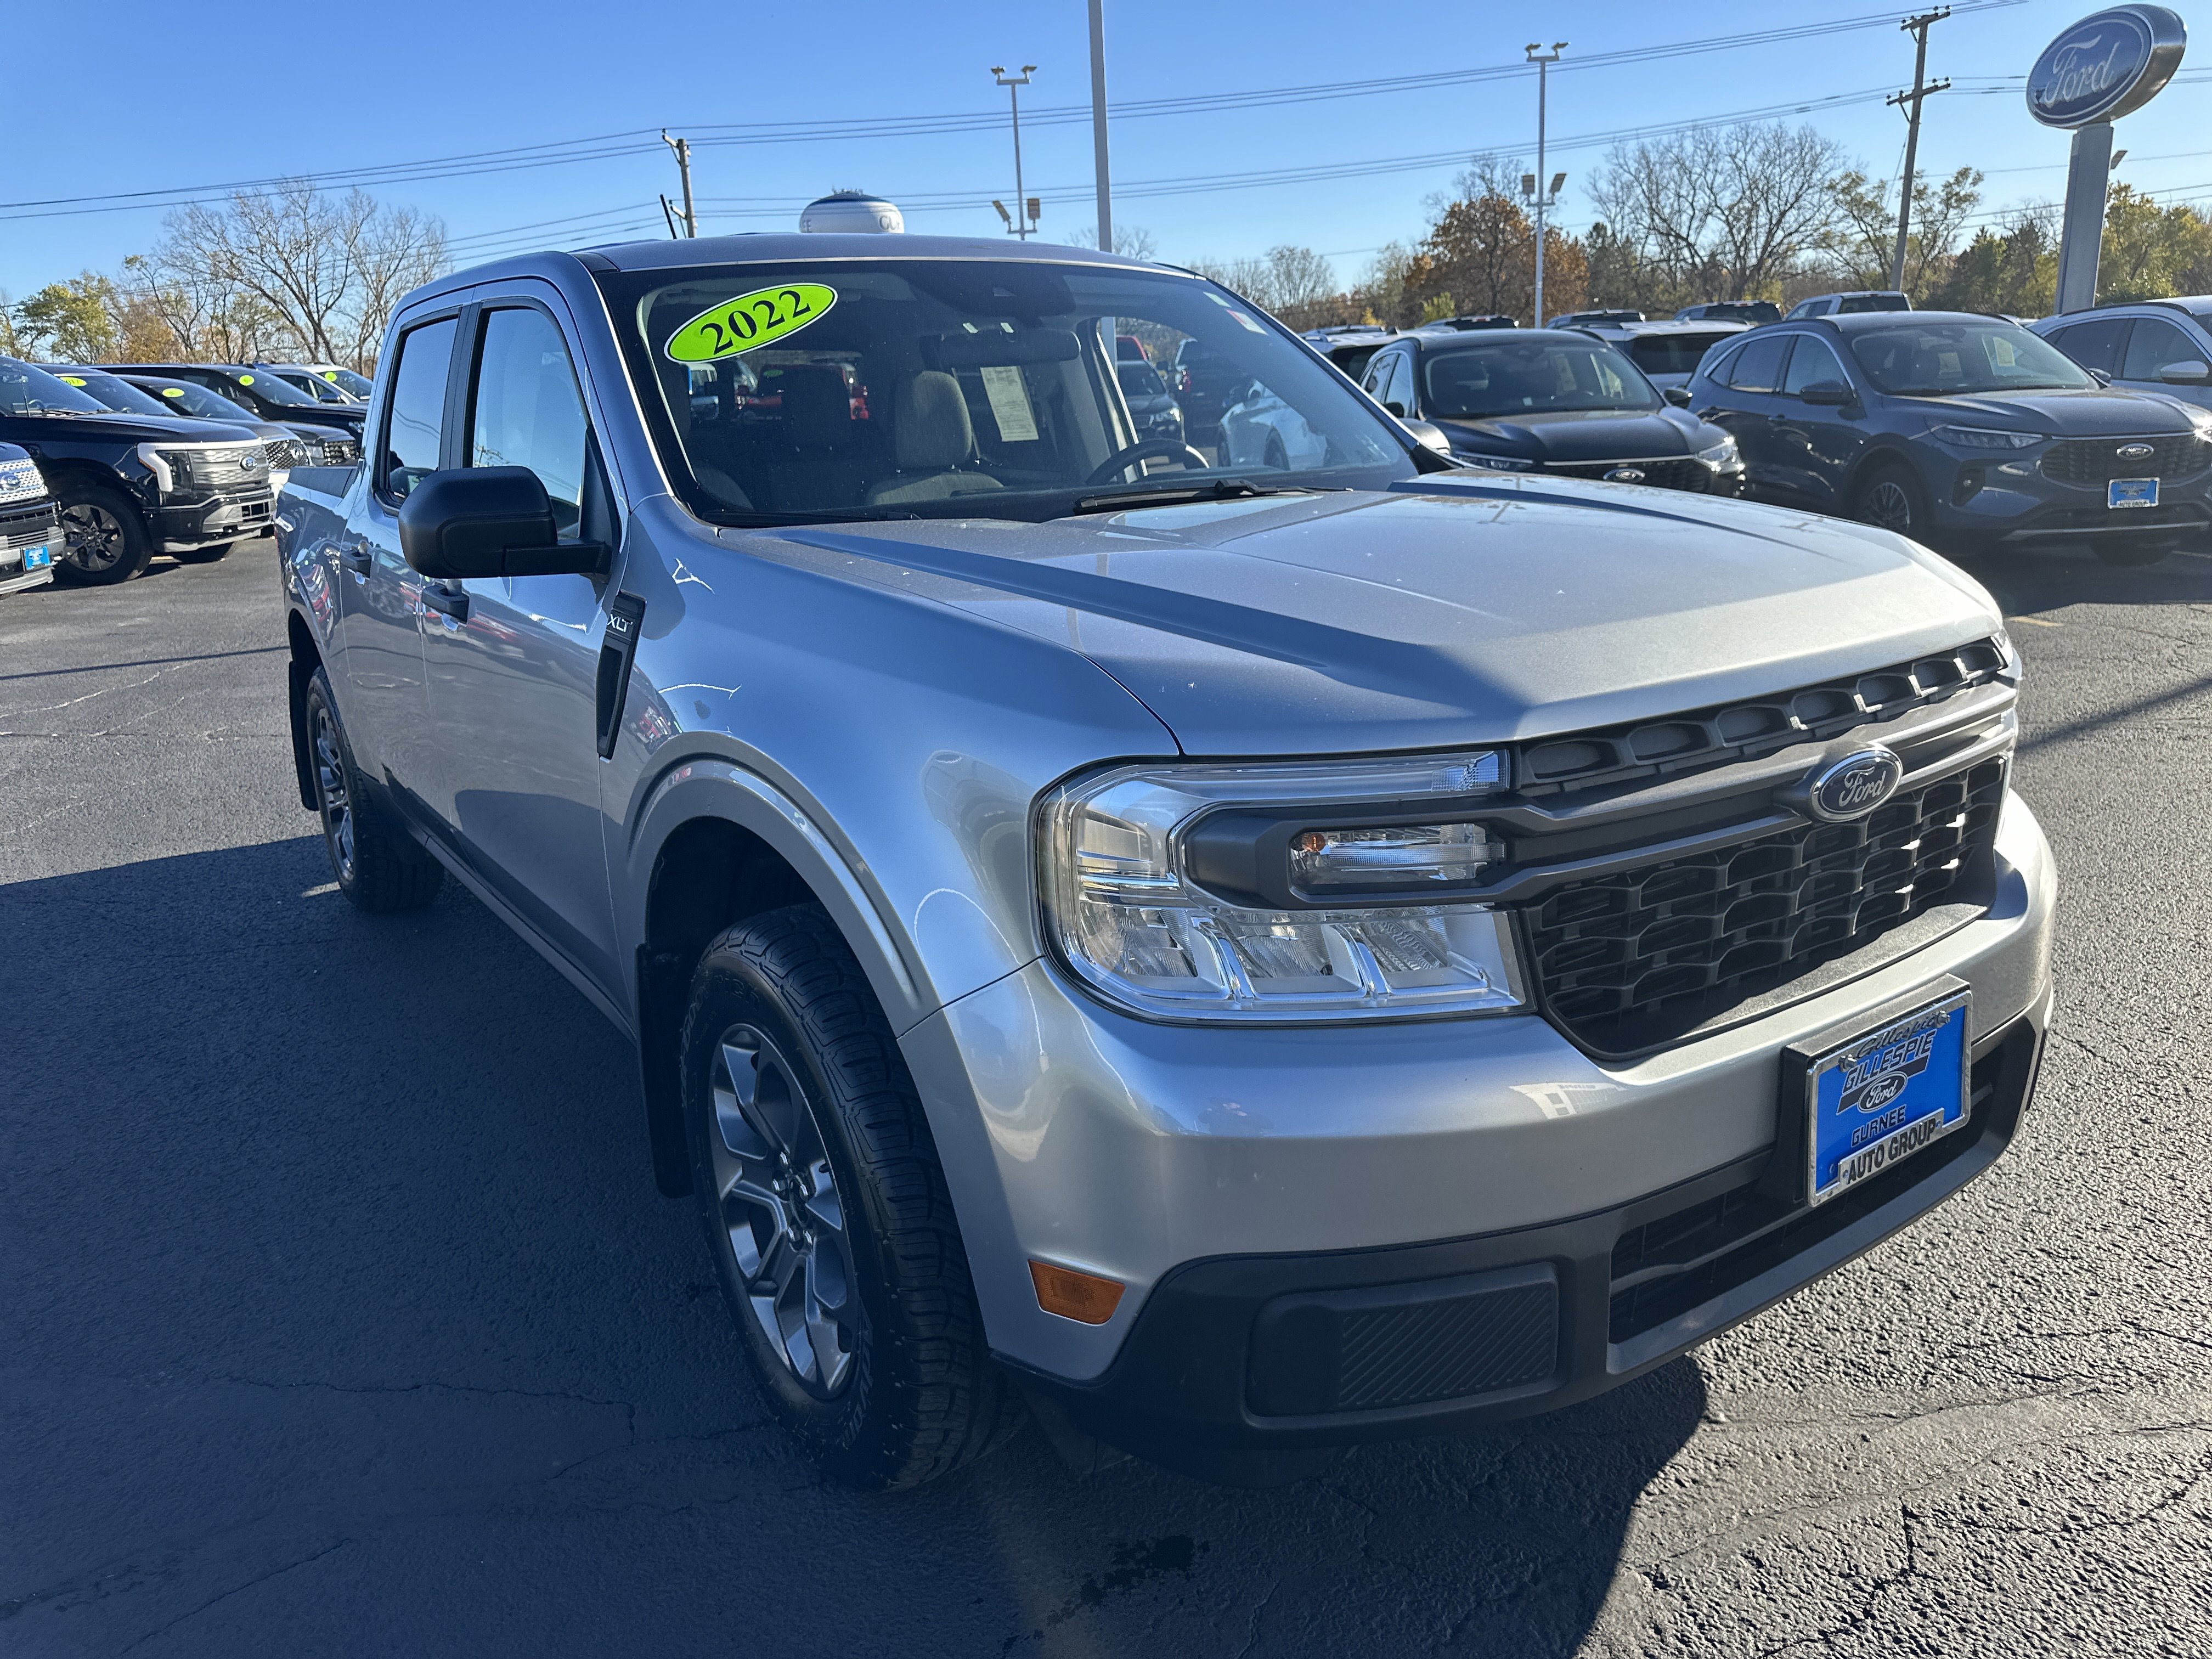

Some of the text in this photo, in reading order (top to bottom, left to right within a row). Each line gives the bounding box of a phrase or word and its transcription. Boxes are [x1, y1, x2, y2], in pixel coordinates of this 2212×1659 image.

[2045, 34, 2120, 108] Ford
[700, 290, 811, 354] 2022
[607, 614, 633, 633] XLT
[1838, 766, 1887, 807] Ford
[1843, 1029, 1937, 1093] GILLESPIE
[1865, 1079, 1898, 1107] Ford
[1847, 1118, 1937, 1184] AUTO GROUP
[1851, 1105, 1907, 1147] GURNEE
